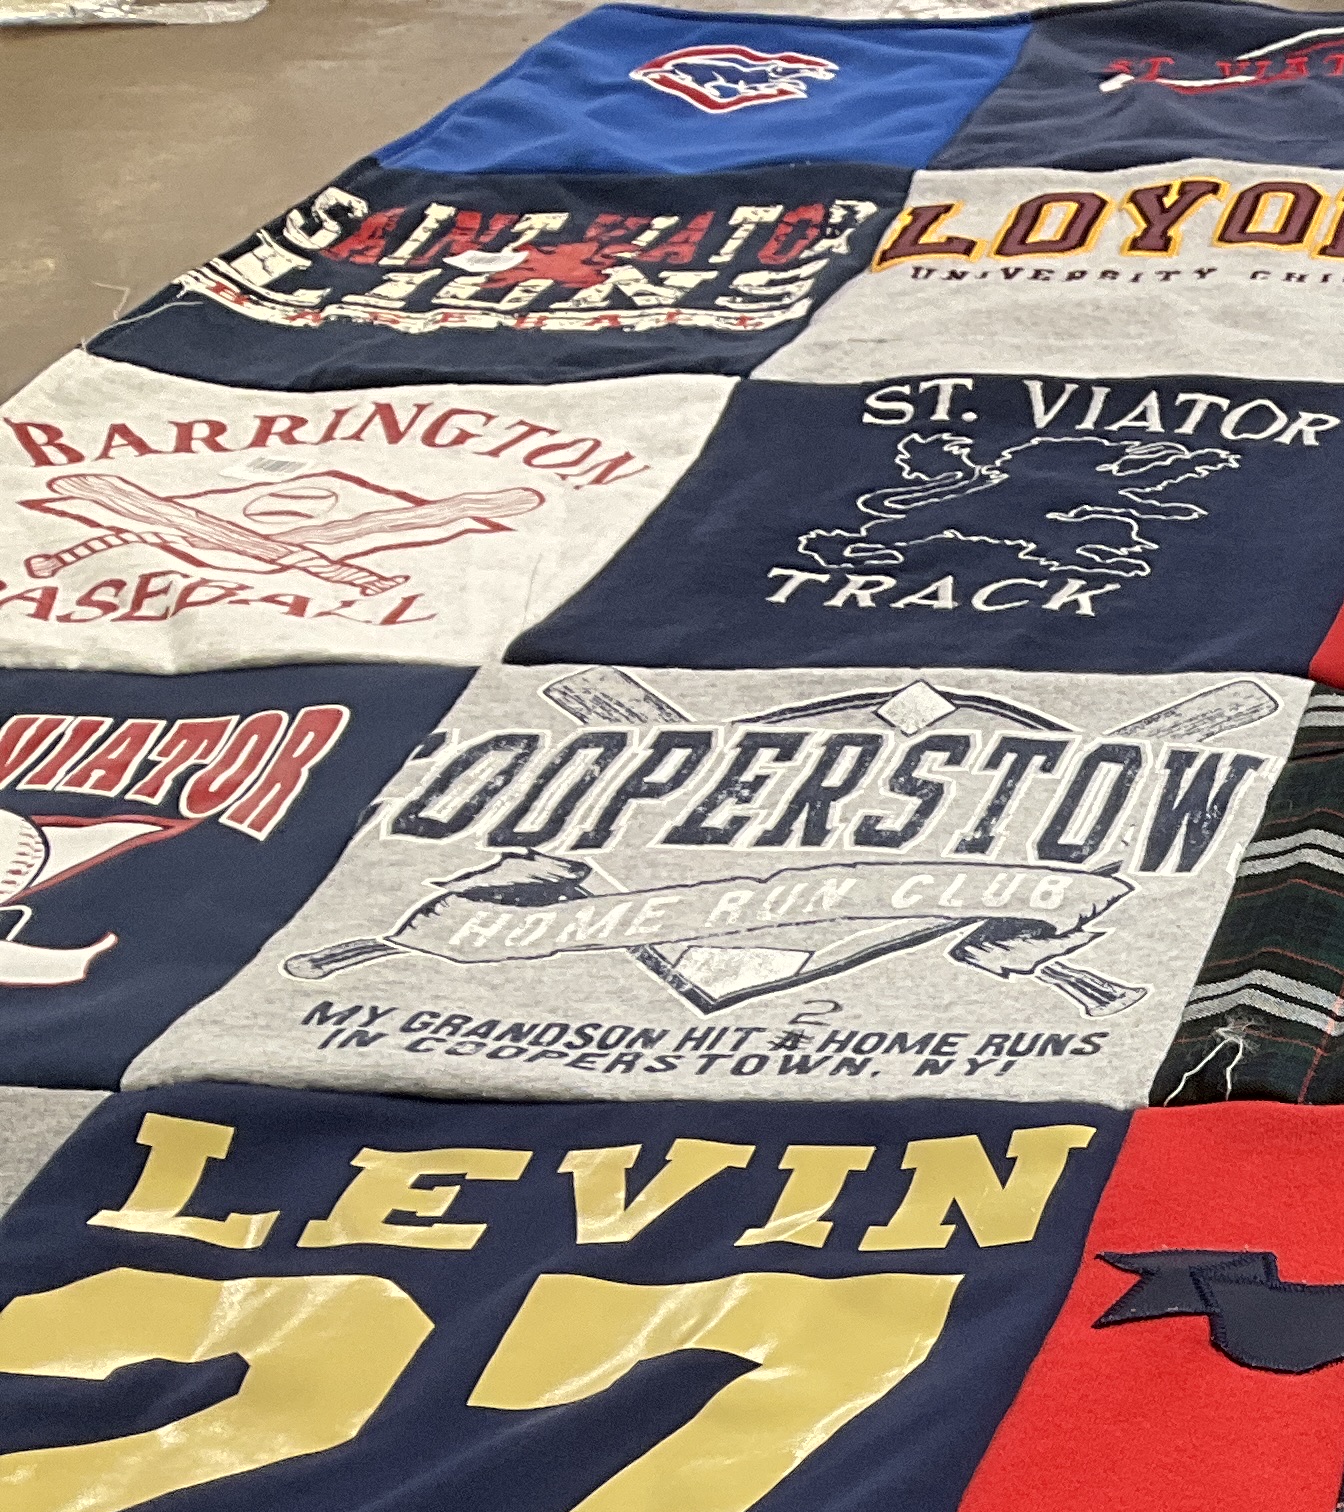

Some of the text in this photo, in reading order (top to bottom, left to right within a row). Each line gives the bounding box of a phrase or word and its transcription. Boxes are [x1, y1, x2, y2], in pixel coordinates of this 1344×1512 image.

[2, 400, 653, 490] BARRINGTON
[862, 377, 1342, 446] ST. VIATOR
[0, 570, 438, 626] ASEBALL
[766, 567, 1121, 616] TRACK
[0, 705, 351, 841] VIATOR
[360, 725, 1288, 877] OOPERSTOW
[447, 872, 1075, 948] HOME RUN CLUB
[300, 999, 399, 1028] MY
[399, 1010, 671, 1051] GRANDSON
[672, 1026, 767, 1053] HIT
[814, 1030, 969, 1057] HOME
[974, 1030, 1111, 1057] RUNS
[317, 1028, 389, 1050] IN
[911, 1057, 1019, 1078] NY!
[86, 1111, 1097, 1252] LEVIN
